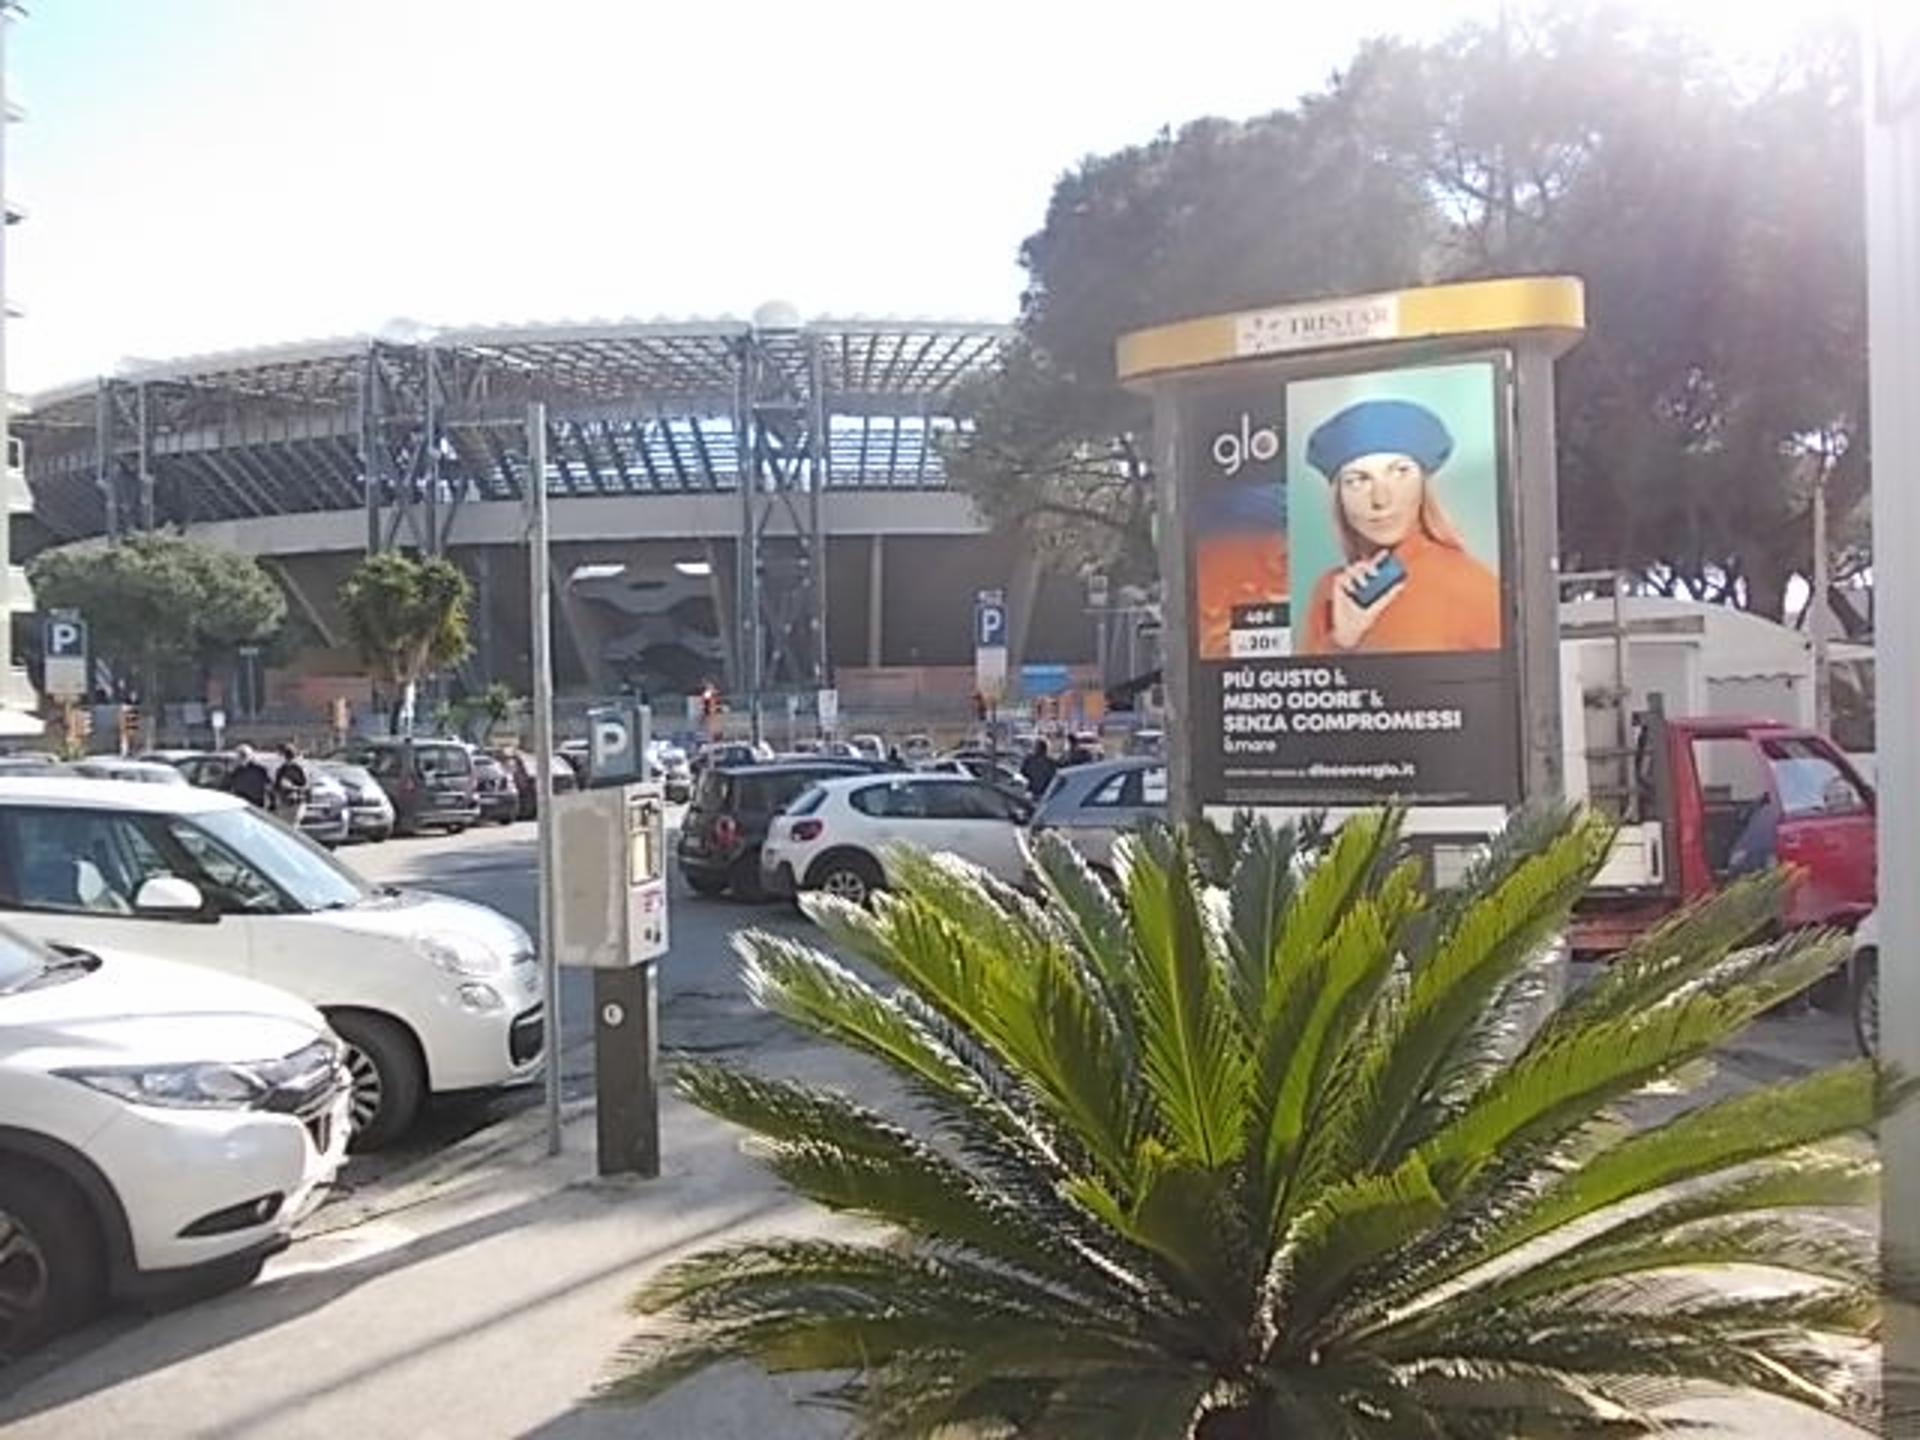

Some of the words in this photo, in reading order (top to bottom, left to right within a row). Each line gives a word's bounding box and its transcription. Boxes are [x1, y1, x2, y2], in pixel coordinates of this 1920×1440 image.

[1213, 411, 1279, 475] glo
[53, 624, 77, 653] P
[982, 607, 1002, 643] P
[1223, 665, 1255, 689] PIÙ
[1259, 669, 1331, 689] GUSTO
[1223, 692, 1283, 712] MENO
[1223, 713, 1288, 733] SENZA
[1292, 711, 1462, 732] COMPROMESSI
[595, 722, 627, 767] P
